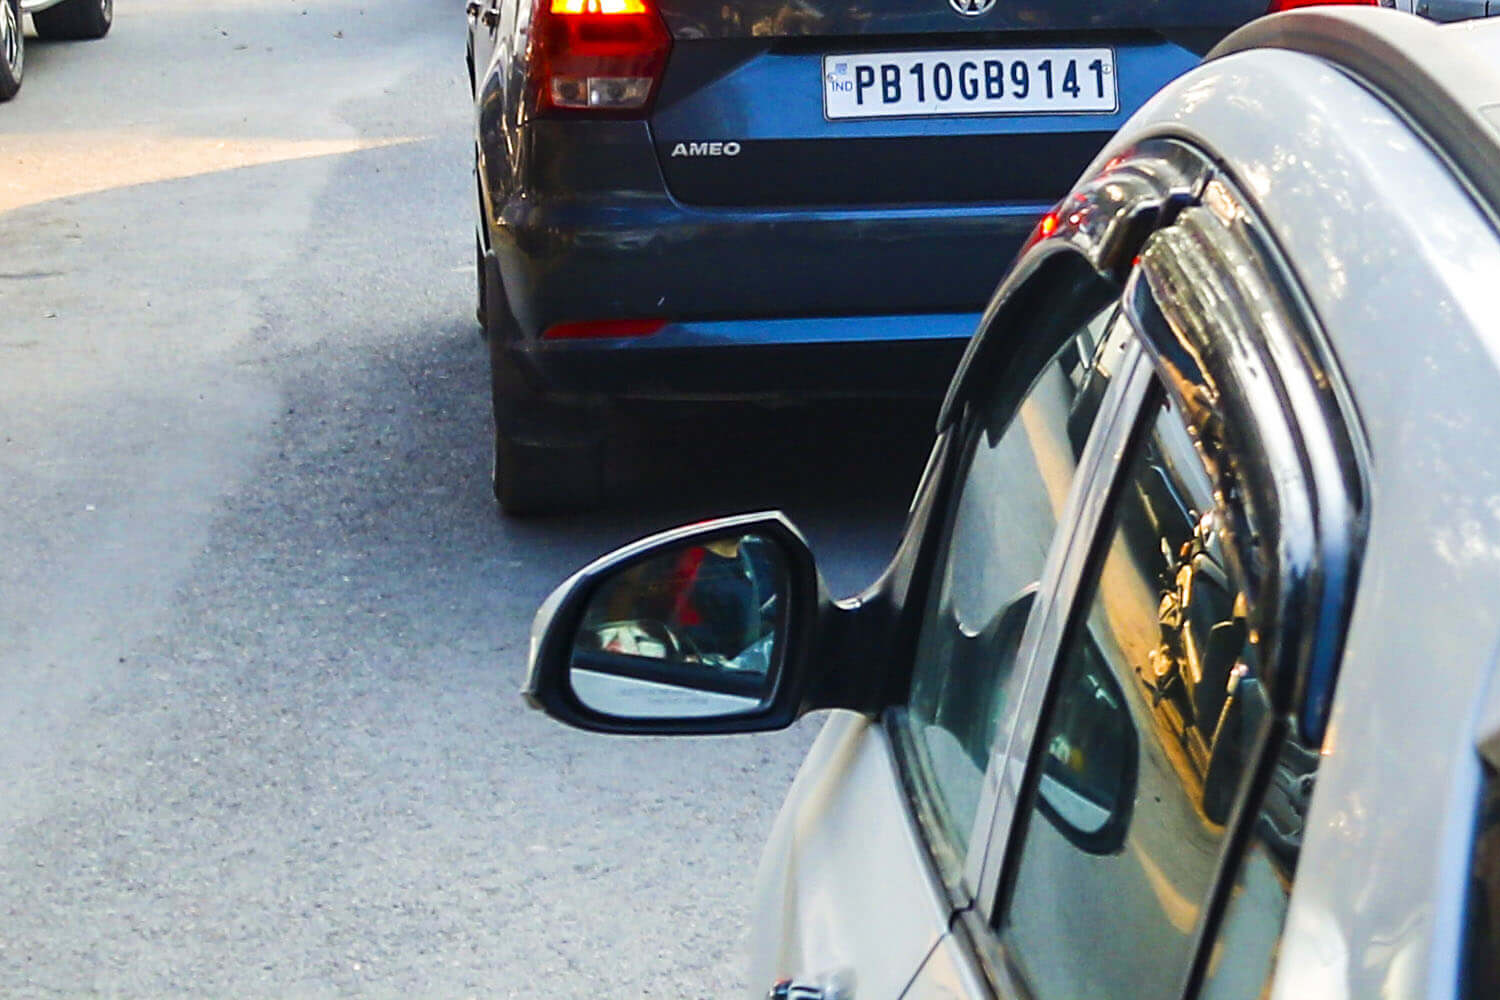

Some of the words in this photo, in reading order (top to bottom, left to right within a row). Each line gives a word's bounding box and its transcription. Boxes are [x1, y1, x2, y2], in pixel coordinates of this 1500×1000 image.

[831, 80, 854, 92] IND
[855, 59, 1104, 105] PB10GB9141
[671, 142, 741, 157] AMEO
